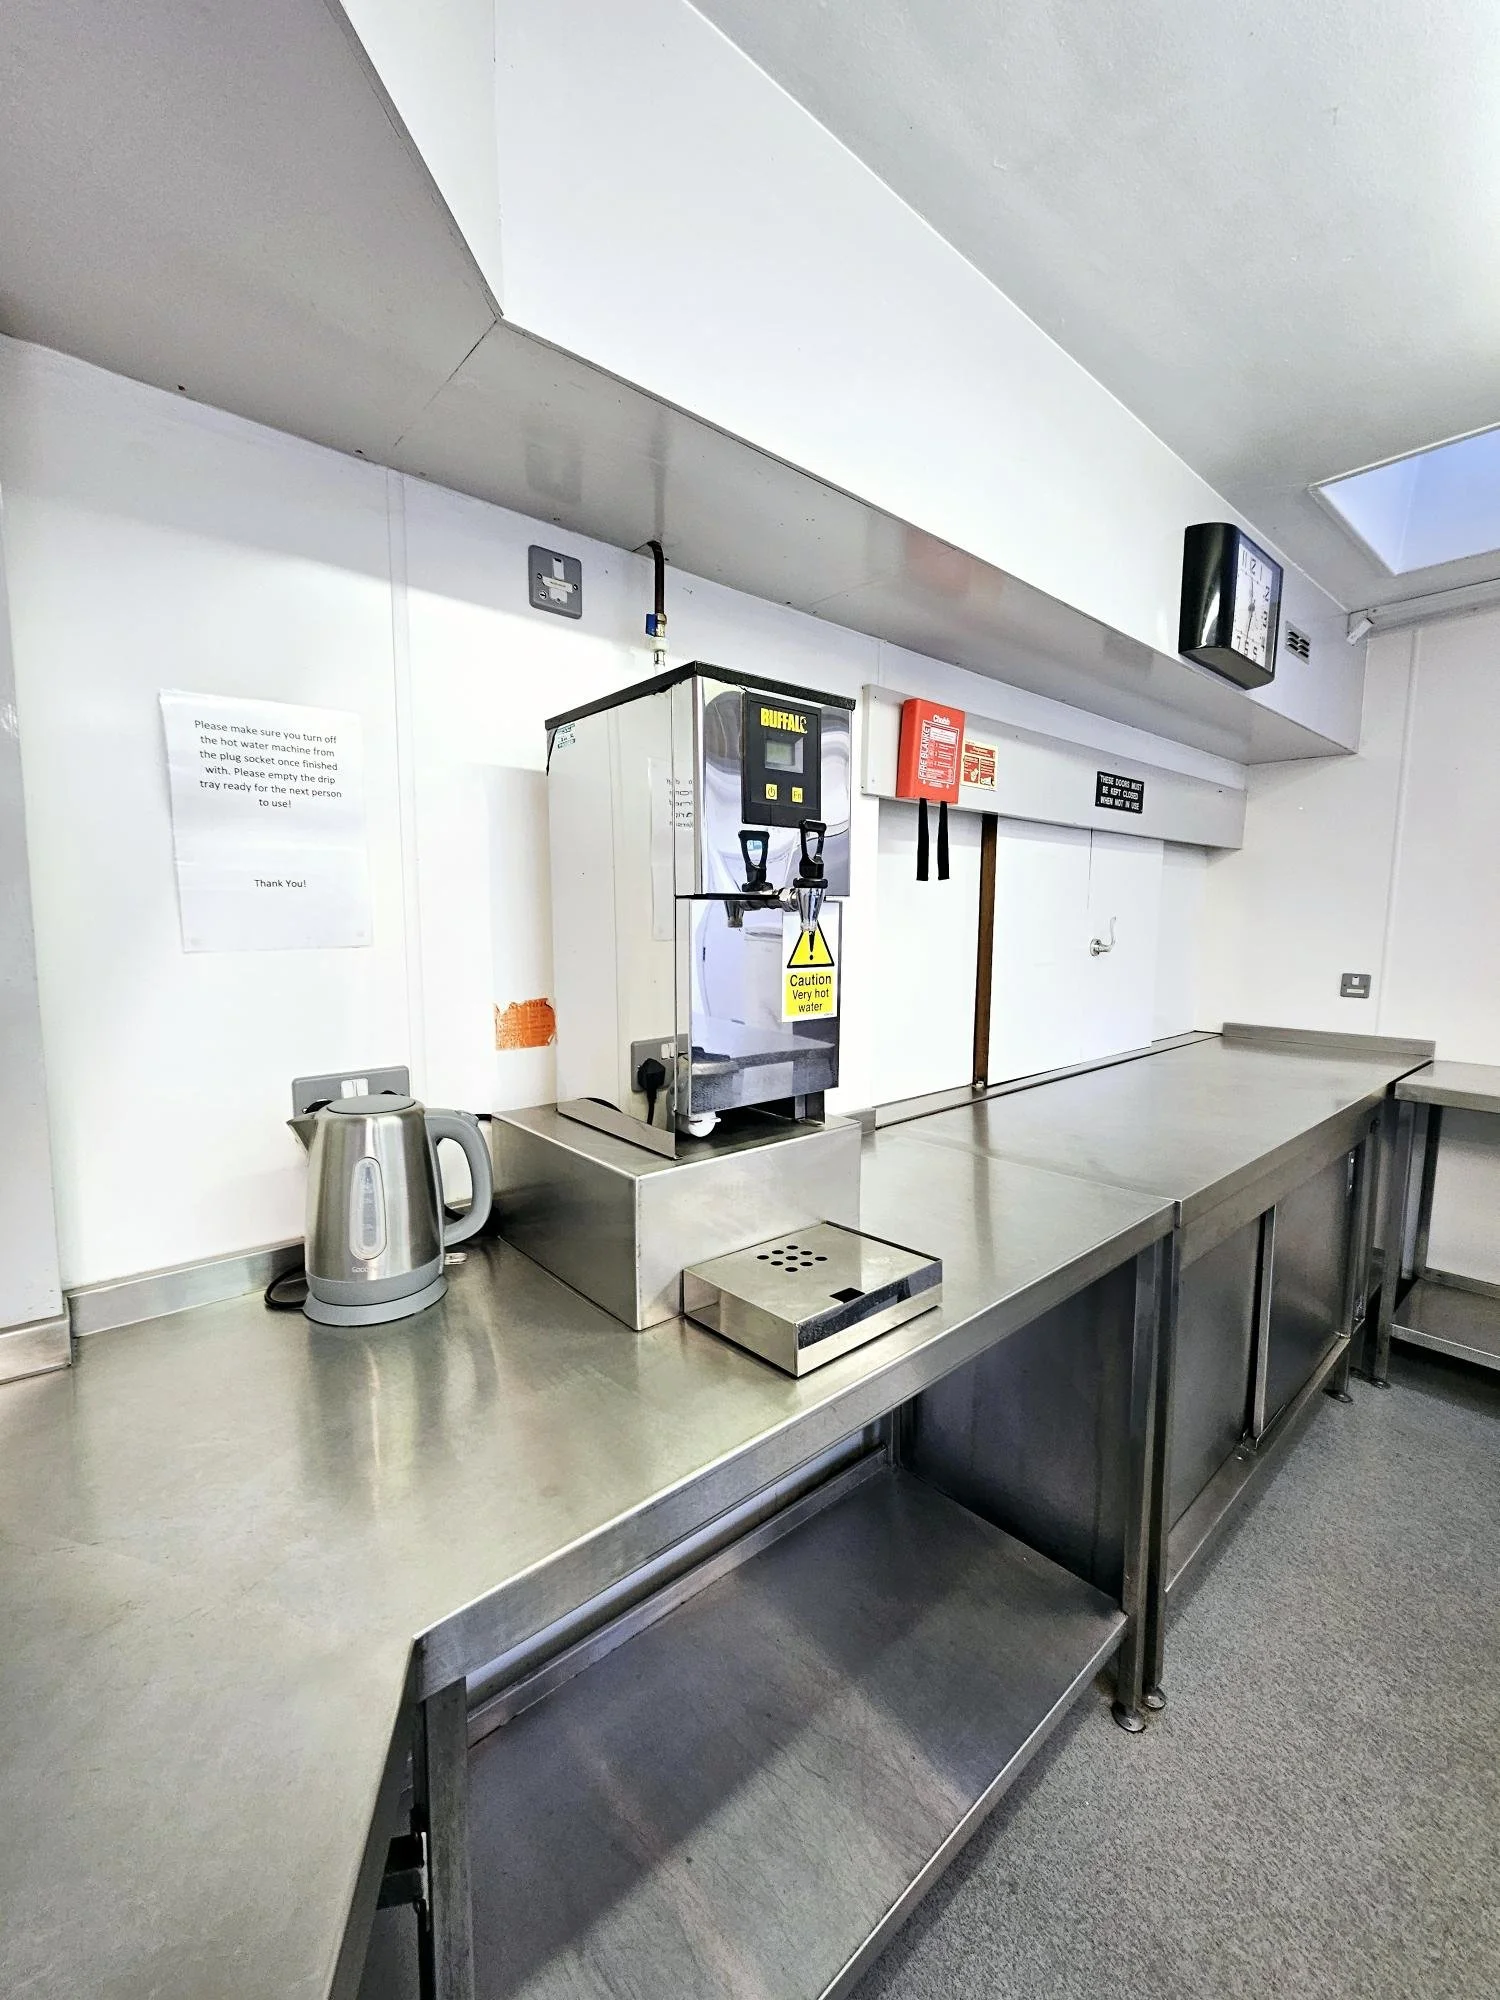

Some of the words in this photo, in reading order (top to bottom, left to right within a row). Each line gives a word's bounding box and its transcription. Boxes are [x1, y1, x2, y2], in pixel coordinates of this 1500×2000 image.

[760, 707, 808, 734] BUFFALO
[194, 719, 228, 732] Please
[230, 725, 258, 735] make
[260, 729, 281, 738] sure
[283, 731, 301, 741] you
[303, 733, 322, 743] turn
[324, 735, 337, 744] off
[200, 735, 218, 745] the
[220, 737, 238, 747] hot
[240, 741, 269, 750] water
[271, 744, 311, 755] machine
[313, 746, 335, 757] from
[199, 750, 217, 760] the
[219, 752, 242, 763] plug
[243, 755, 275, 765] socket
[277, 759, 300, 767] once
[302, 760, 338, 771] finished
[919, 760, 928, 777] FIRE
[205, 765, 231, 775] with.
[234, 767, 266, 778] Please
[268, 772, 298, 782] empty
[300, 773, 316, 783] the
[317, 775, 336, 785] drip
[1100, 774, 1115, 786] THESE
[1115, 779, 1130, 788] DOORS
[1131, 782, 1142, 791] MUST
[199, 780, 221, 790] tray
[223, 781, 252, 792] ready
[254, 783, 269, 793] for
[270, 785, 287, 794] the
[289, 788, 310, 796] next
[311, 789, 342, 798] person
[1102, 785, 1109, 794] BE
[1110, 787, 1122, 796] KEPT
[1122, 790, 1139, 800] CLOSED
[258, 799, 270, 807] to
[271, 800, 292, 808] use!
[1100, 796, 1114, 805] WHEN
[1114, 798, 1124, 807] NOT
[1125, 800, 1131, 808] IN
[1131, 802, 1140, 810] USE
[253, 879, 283, 888] Thank
[285, 879, 307, 888] You!
[789, 973, 832, 987] Caution
[792, 989, 812, 1002] Very
[814, 988, 830, 999] hot
[798, 1002, 823, 1013] water
